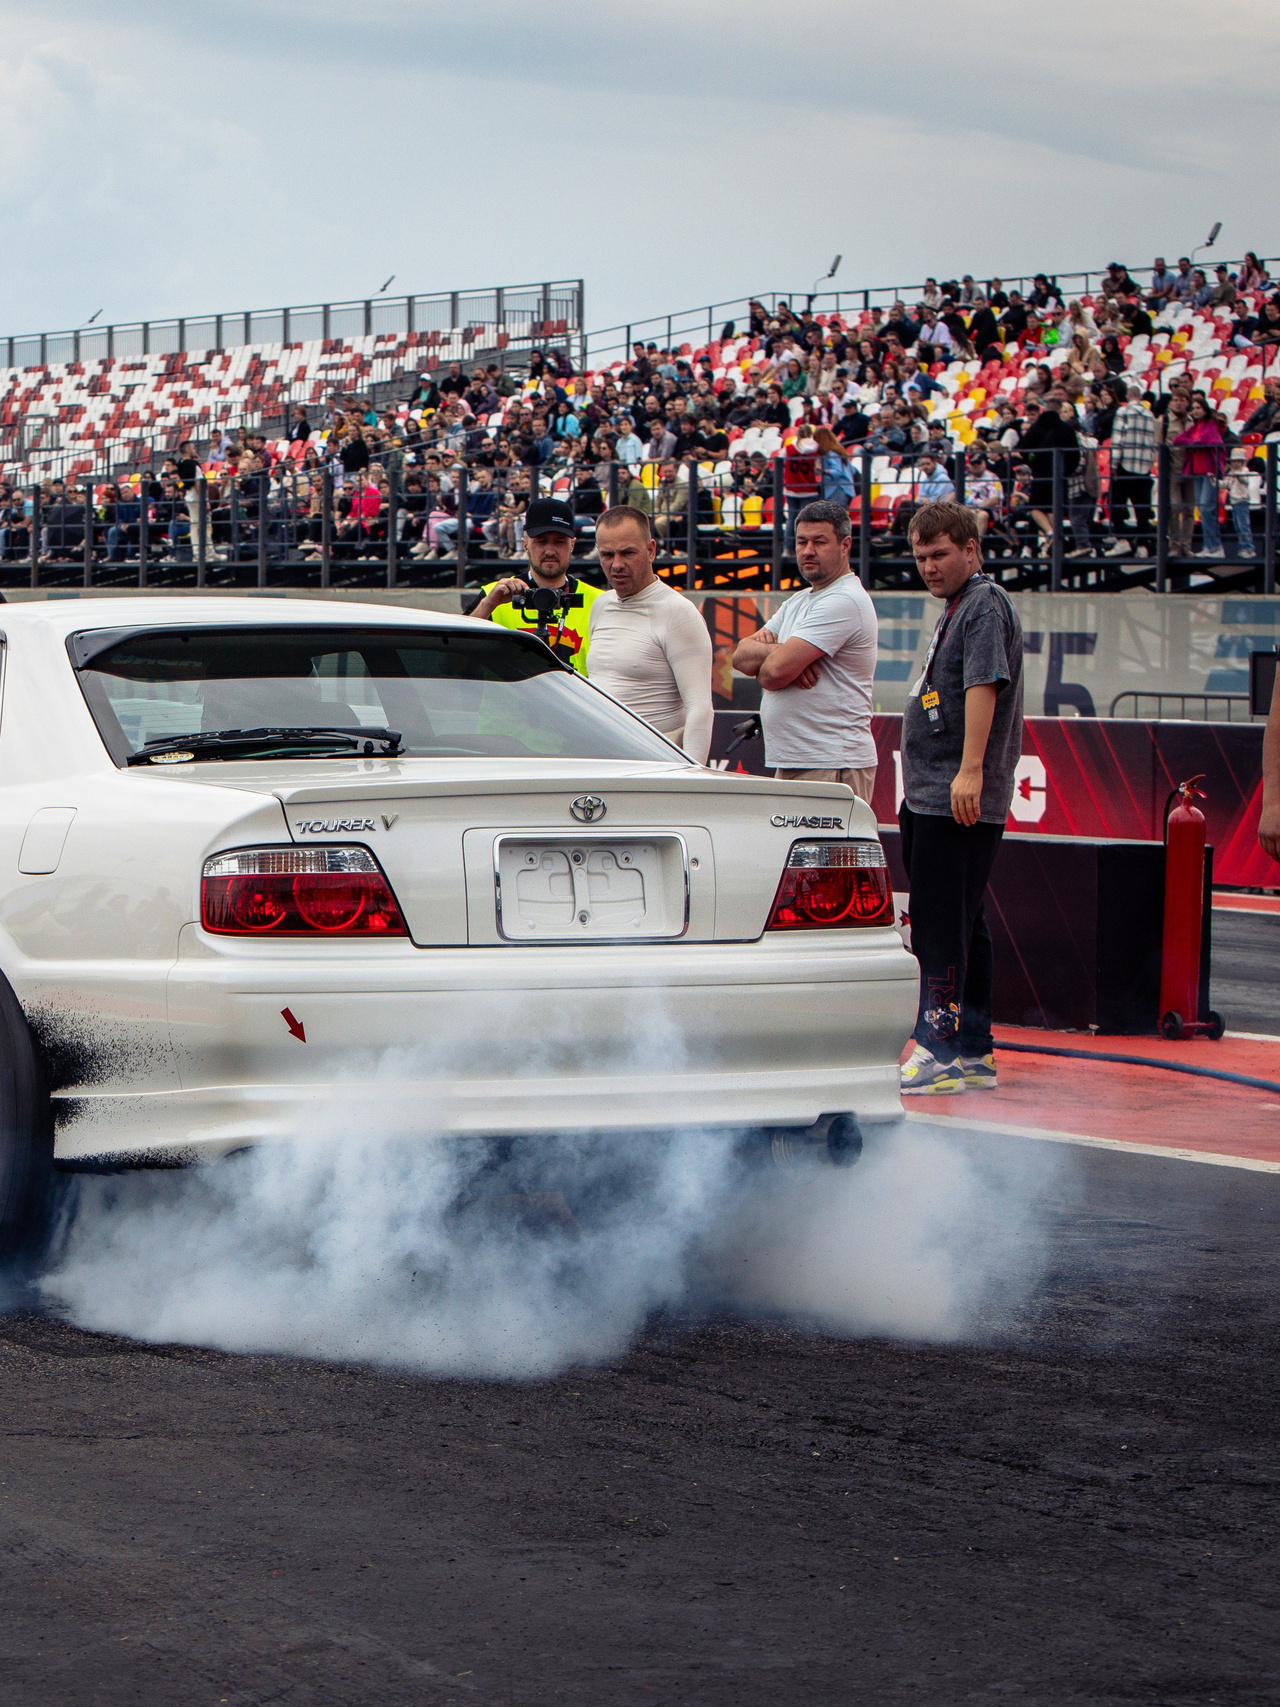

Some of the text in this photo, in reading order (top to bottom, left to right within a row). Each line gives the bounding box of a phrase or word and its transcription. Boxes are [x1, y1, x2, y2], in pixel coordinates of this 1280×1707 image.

[296, 814, 399, 834] TOURER V
[770, 814, 845, 830] CHASER
